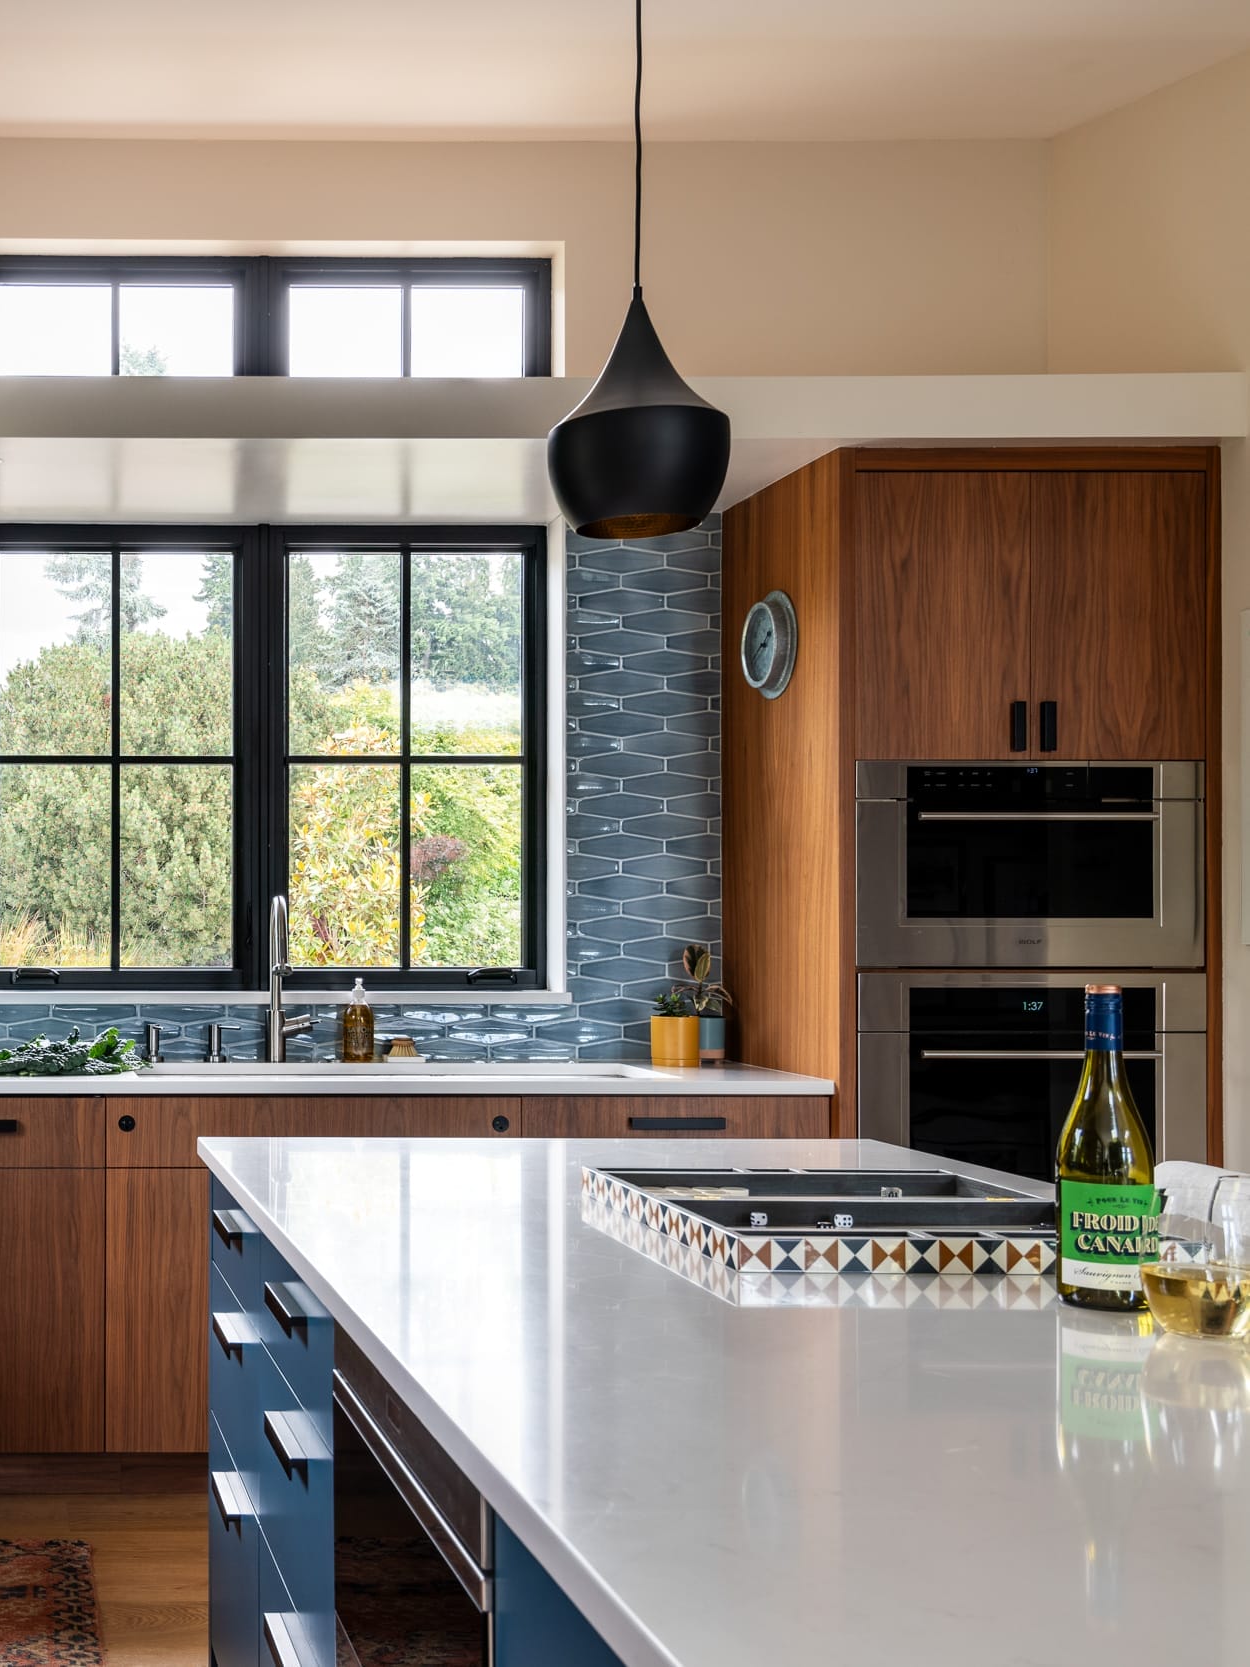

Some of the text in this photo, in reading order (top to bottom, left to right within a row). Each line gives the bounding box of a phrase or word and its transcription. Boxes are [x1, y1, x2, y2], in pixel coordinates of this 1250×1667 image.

[1022, 1001, 1044, 1011] 1:37
[1071, 1211, 1139, 1233] FROID
[1075, 1233, 1159, 1255] CANARD
